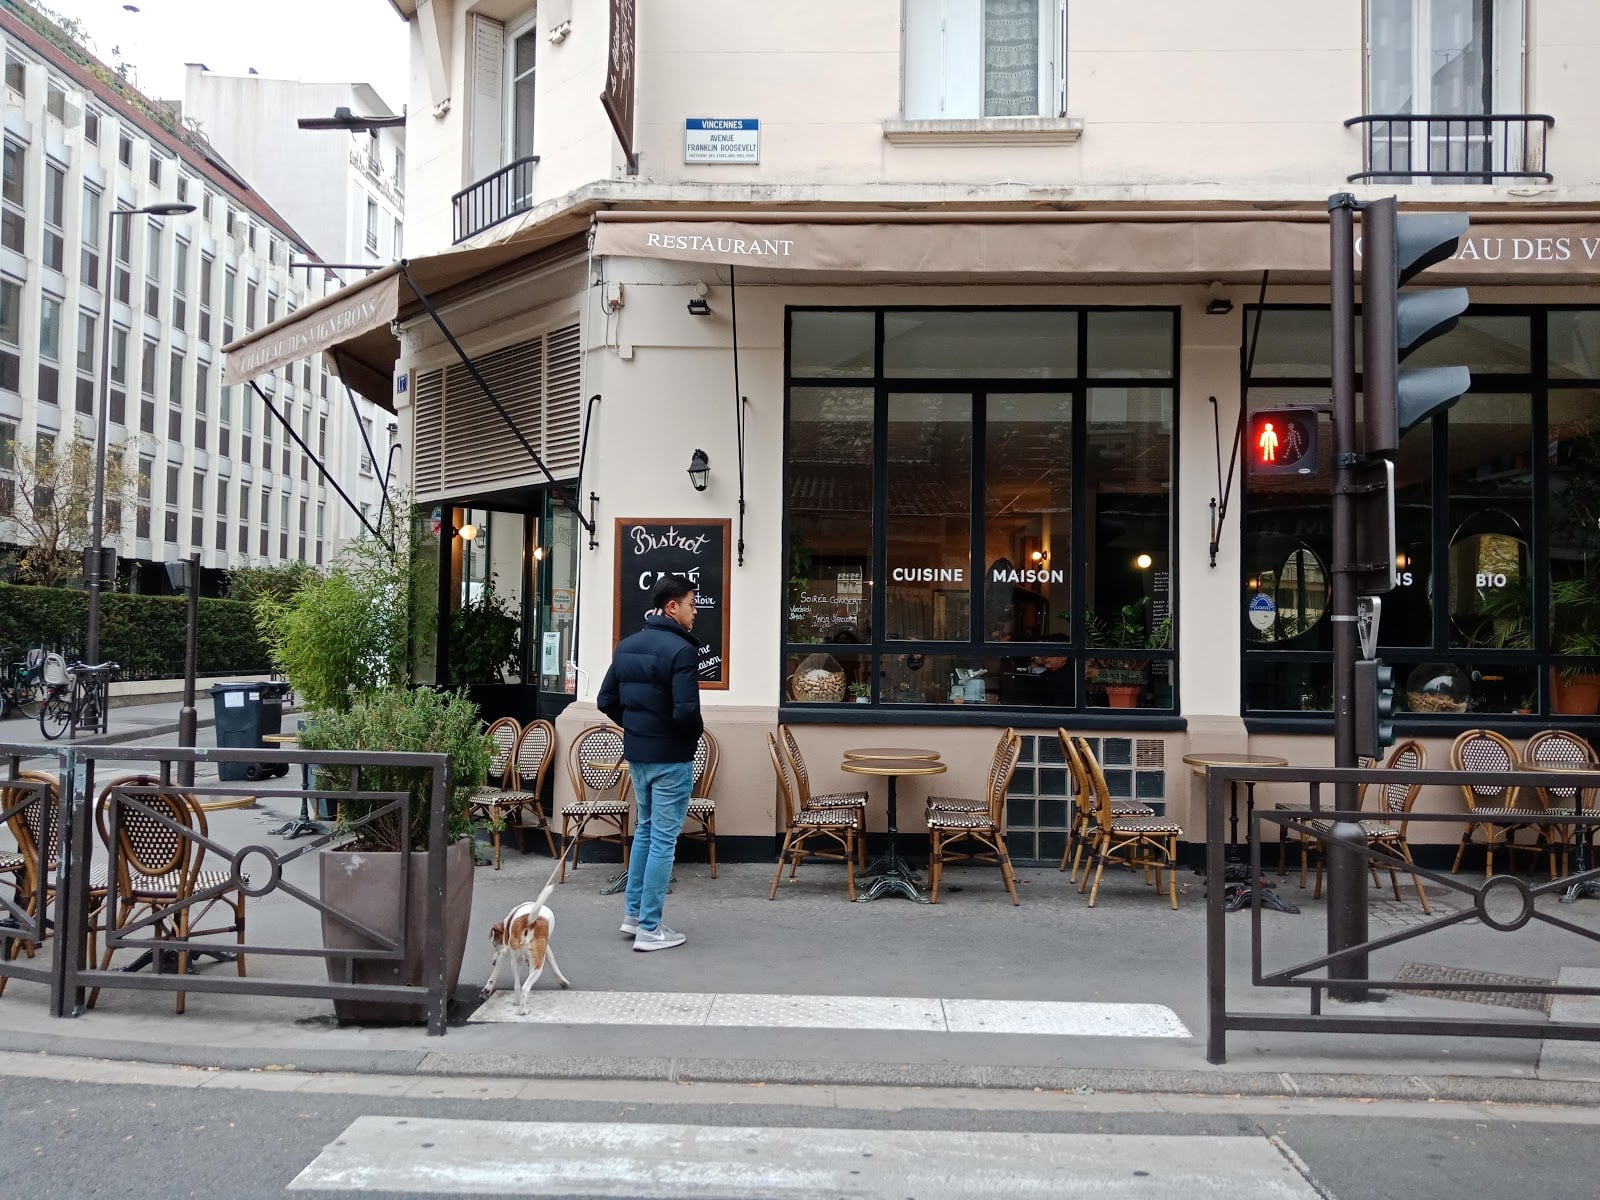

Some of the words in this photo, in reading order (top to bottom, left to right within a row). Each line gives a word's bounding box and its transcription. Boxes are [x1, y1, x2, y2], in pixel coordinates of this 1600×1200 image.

[702, 120, 743, 129] VINCENNES
[709, 134, 735, 142] AVENUE
[687, 143, 718, 152] FRANKLIN
[720, 143, 757, 152] ROOSEVELT
[647, 232, 794, 256] RESTAURANT
[1511, 237, 1571, 260] DES
[308, 299, 376, 342] VIGNERONS
[630, 525, 711, 555] Bistrot
[638, 566, 700, 591] CÉ
[892, 567, 964, 582] CUISINE
[992, 569, 1064, 583] MAISON
[1475, 573, 1507, 588] BIO
[697, 655, 723, 670] aison
